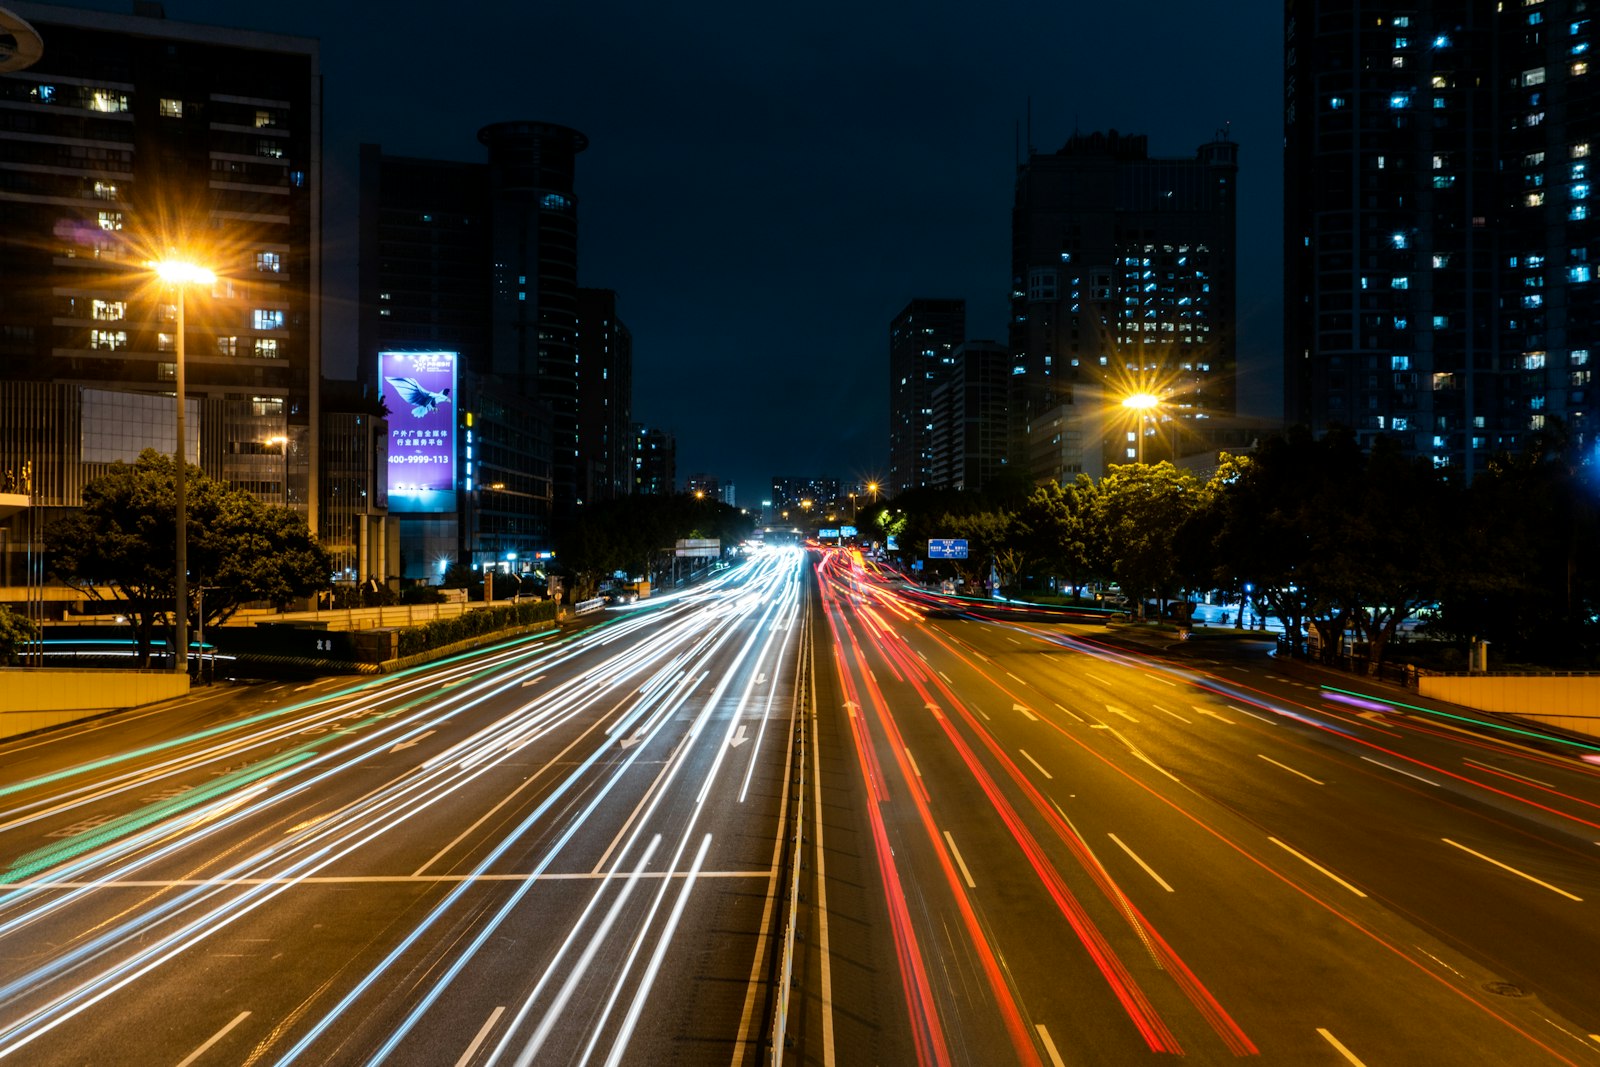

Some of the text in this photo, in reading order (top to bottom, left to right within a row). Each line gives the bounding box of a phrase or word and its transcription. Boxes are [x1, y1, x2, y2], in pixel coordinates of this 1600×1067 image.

[392, 430, 448, 438] 户外广告全媒体
[388, 455, 449, 464] 400-9999-113
